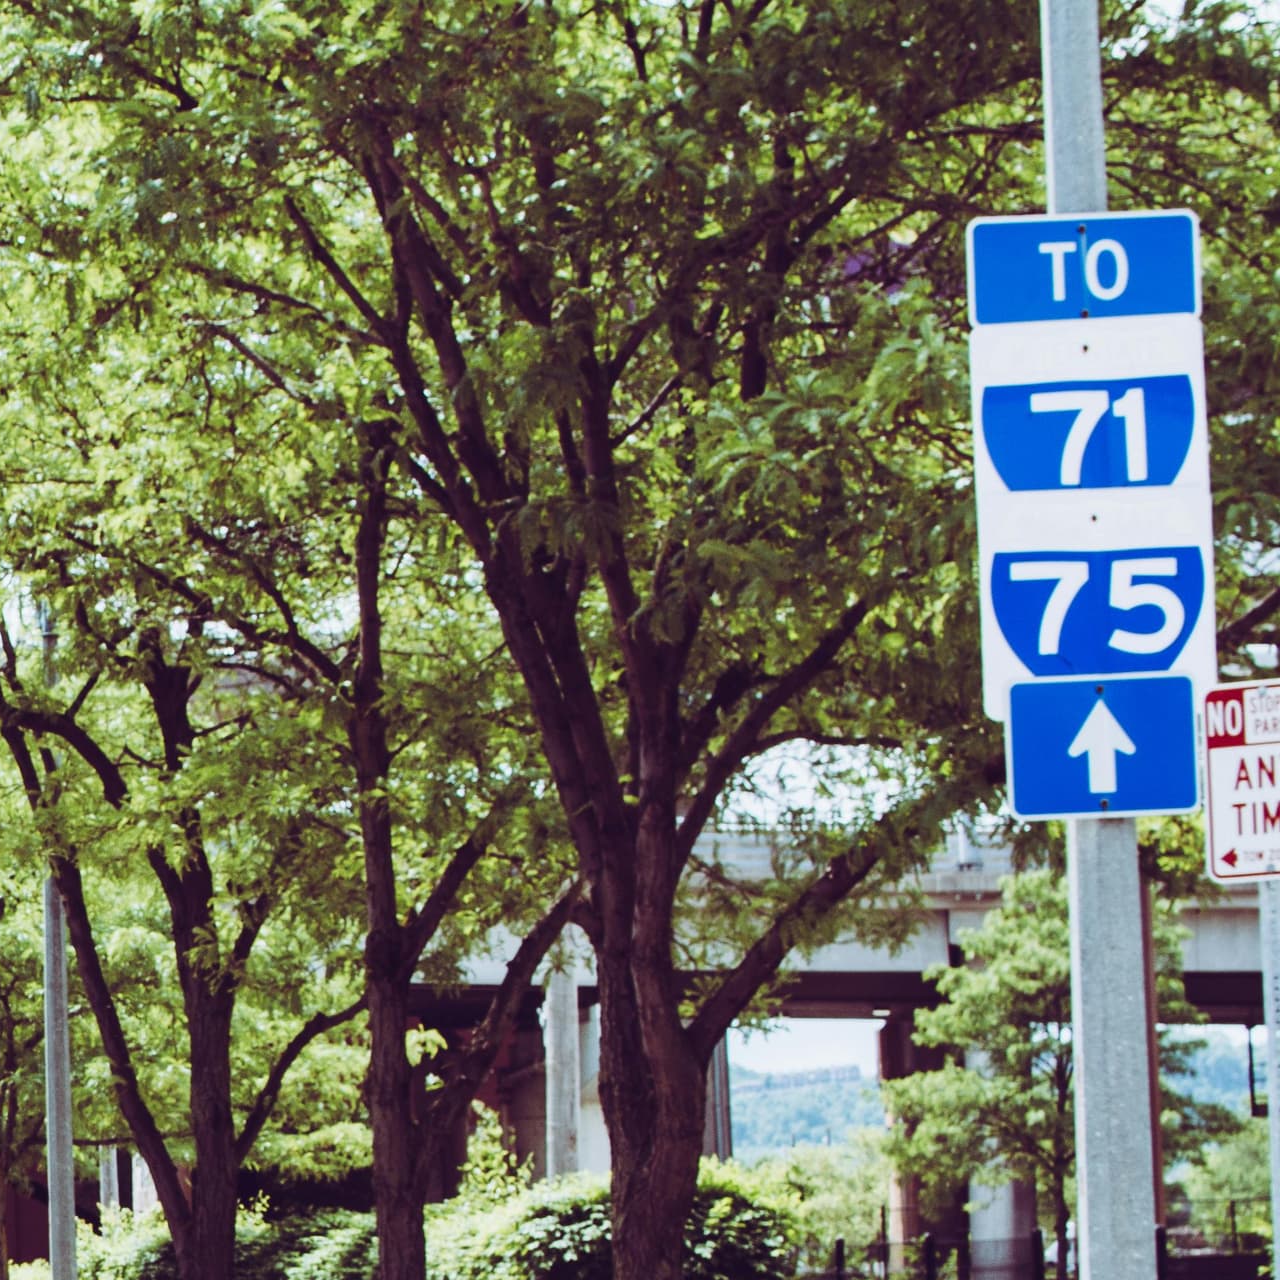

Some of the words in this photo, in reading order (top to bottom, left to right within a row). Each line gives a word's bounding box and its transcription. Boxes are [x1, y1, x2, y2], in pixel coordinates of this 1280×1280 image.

[1039, 239, 1129, 302] TO
[1030, 387, 1148, 487] 71
[1010, 557, 1185, 656] 75
[1206, 699, 1243, 737] NO
[1234, 754, 1280, 790] AN
